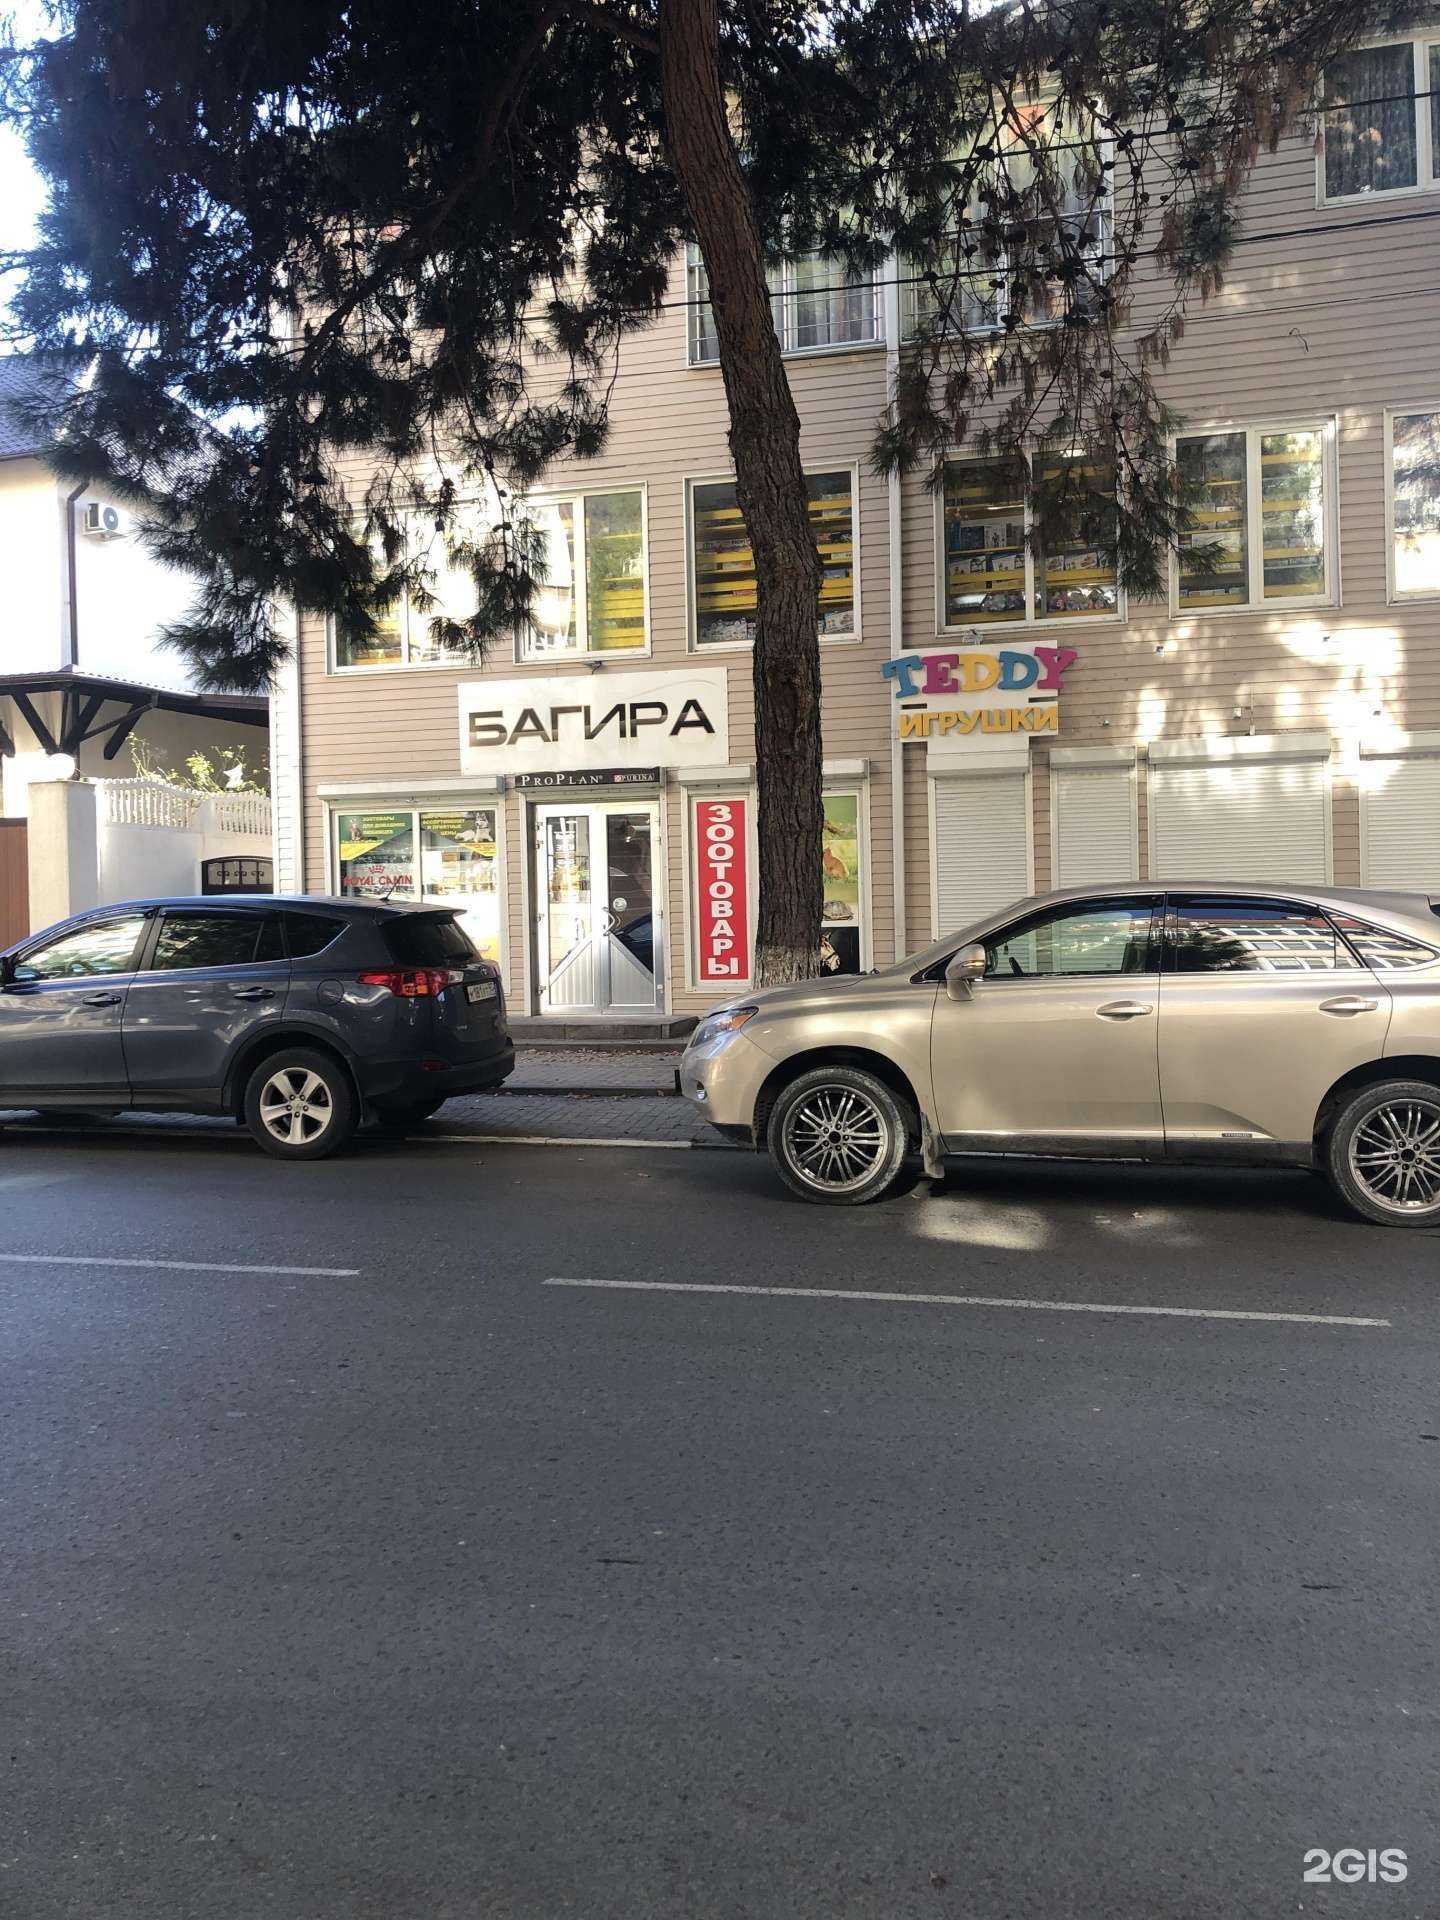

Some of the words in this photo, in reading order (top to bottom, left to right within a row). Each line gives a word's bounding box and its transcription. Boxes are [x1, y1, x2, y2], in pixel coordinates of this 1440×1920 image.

[881, 647, 1078, 698] TEDDY
[469, 699, 716, 747] БАГИРА
[901, 706, 1057, 737] ИГРУШКИ
[344, 876, 375, 886] ROYAL
[706, 804, 739, 976] ЗООТОВАРЫ
